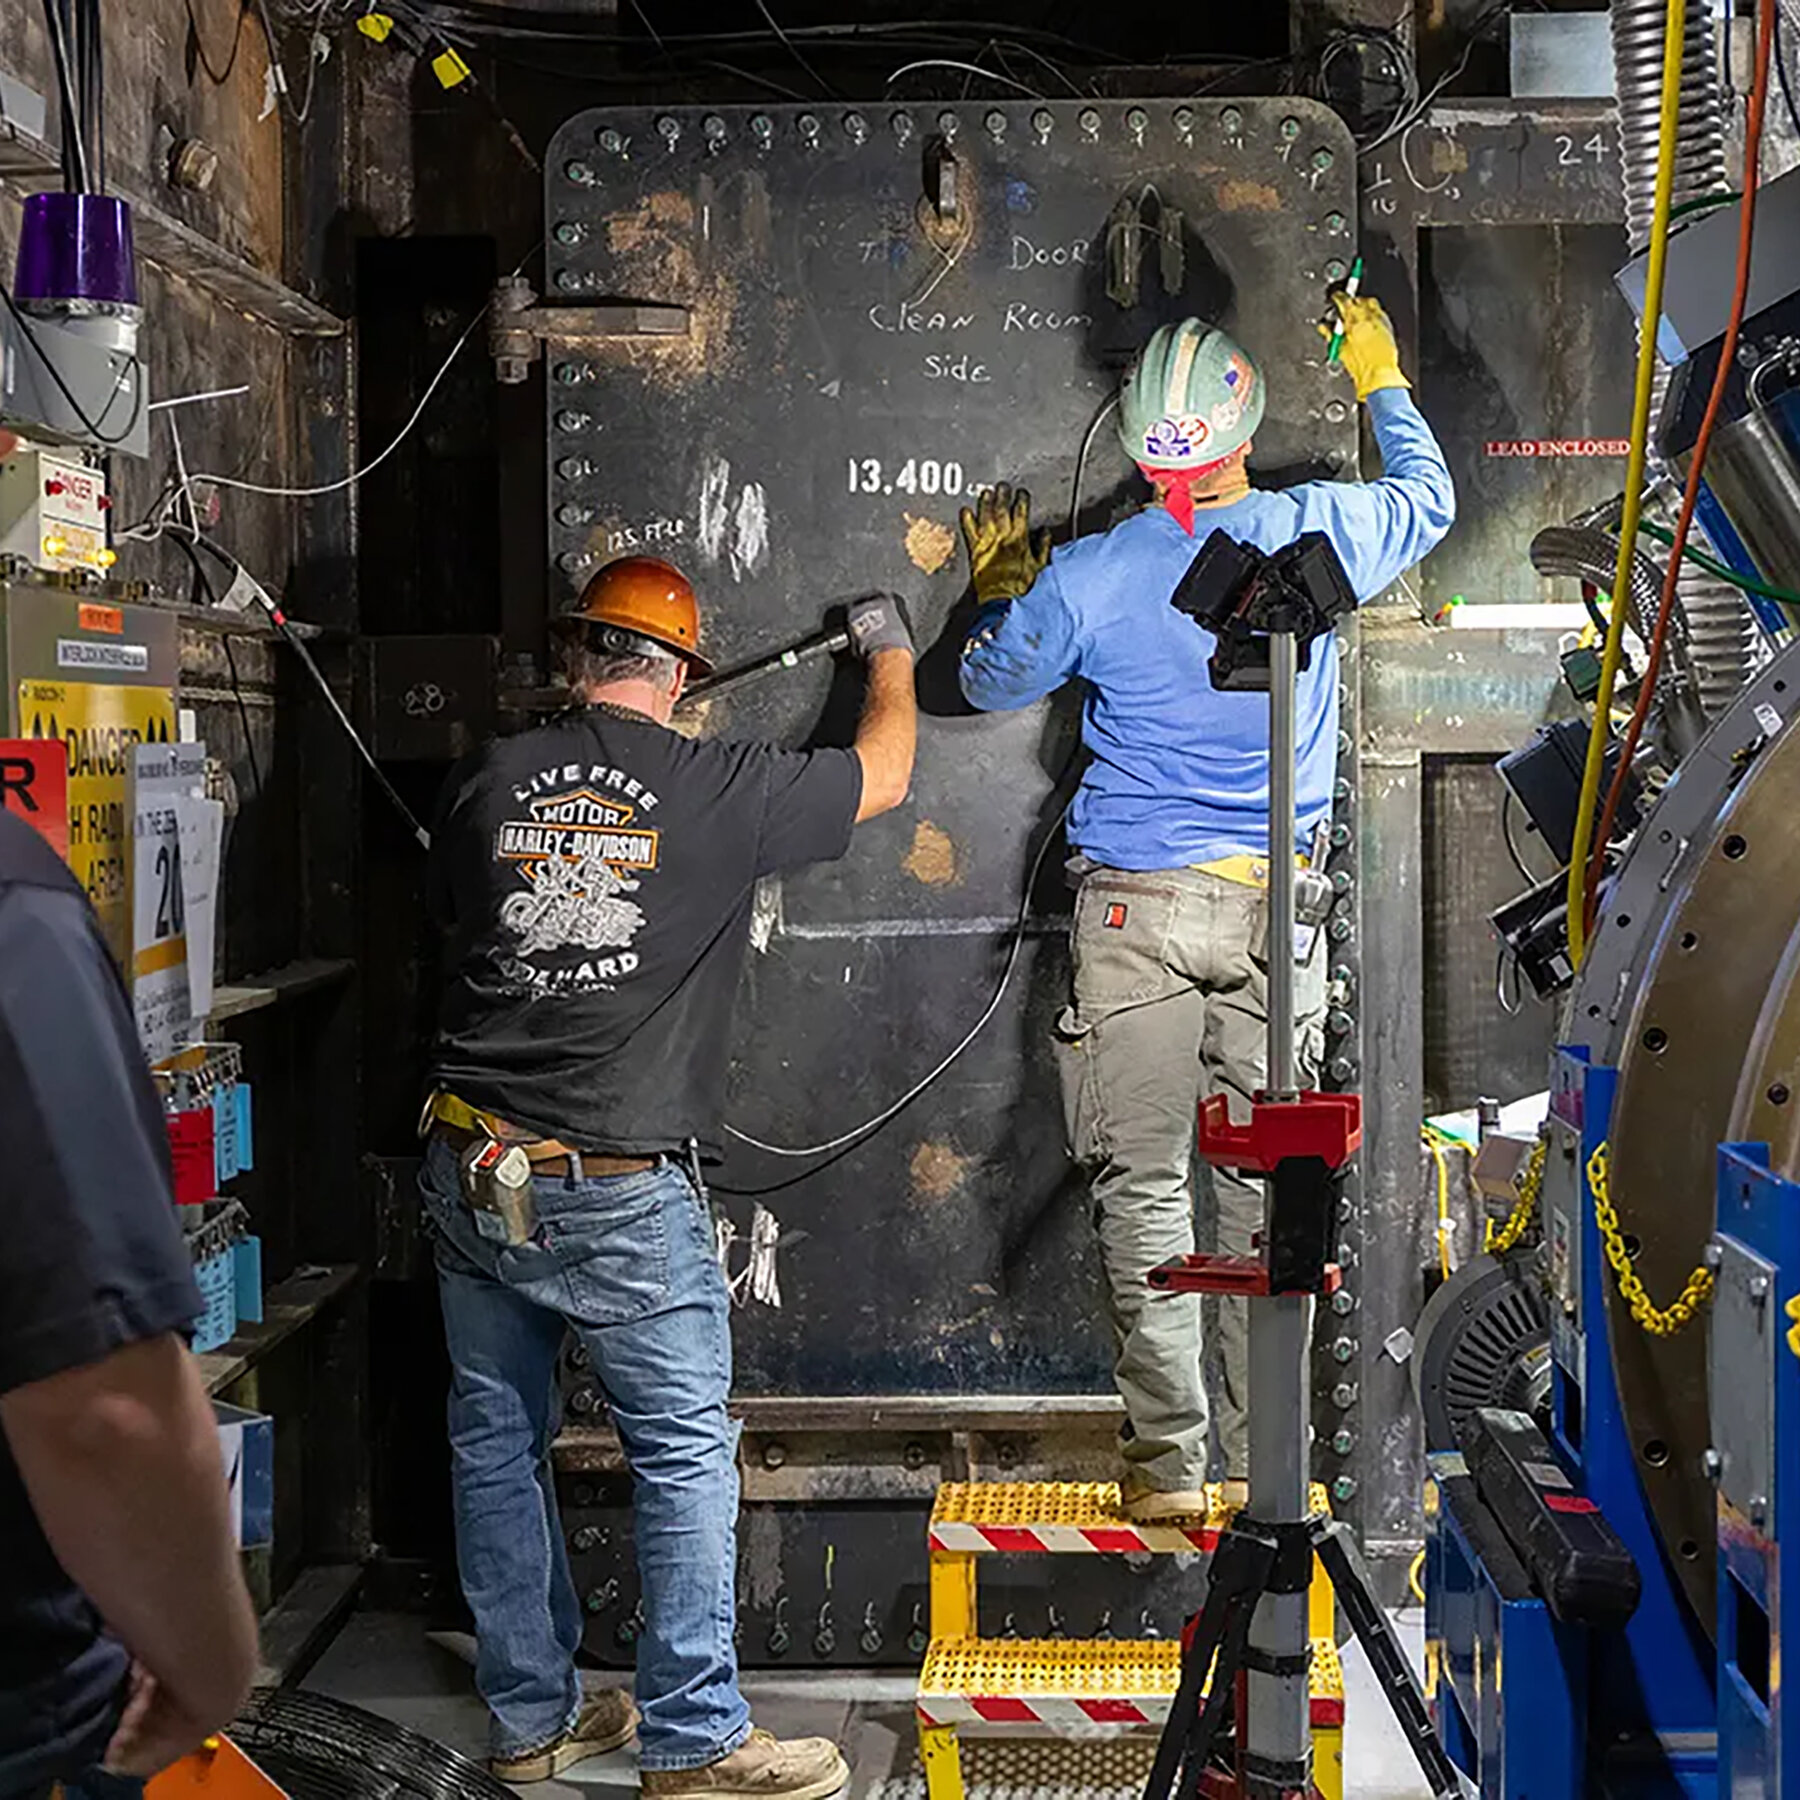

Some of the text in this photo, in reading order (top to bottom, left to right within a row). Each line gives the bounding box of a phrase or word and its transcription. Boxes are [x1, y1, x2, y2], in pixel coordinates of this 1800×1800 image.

[1555, 134, 1610, 165] 24
[923, 355, 992, 382] Side
[1487, 440, 1632, 457] LEAD ENCLOSED
[849, 458, 964, 496] 13.400
[404, 683, 446, 715] 28
[512, 763, 659, 812] LIVE FREE
[543, 798, 620, 826] MOTOR
[503, 826, 653, 864] HARLEY-DAVIDSON
